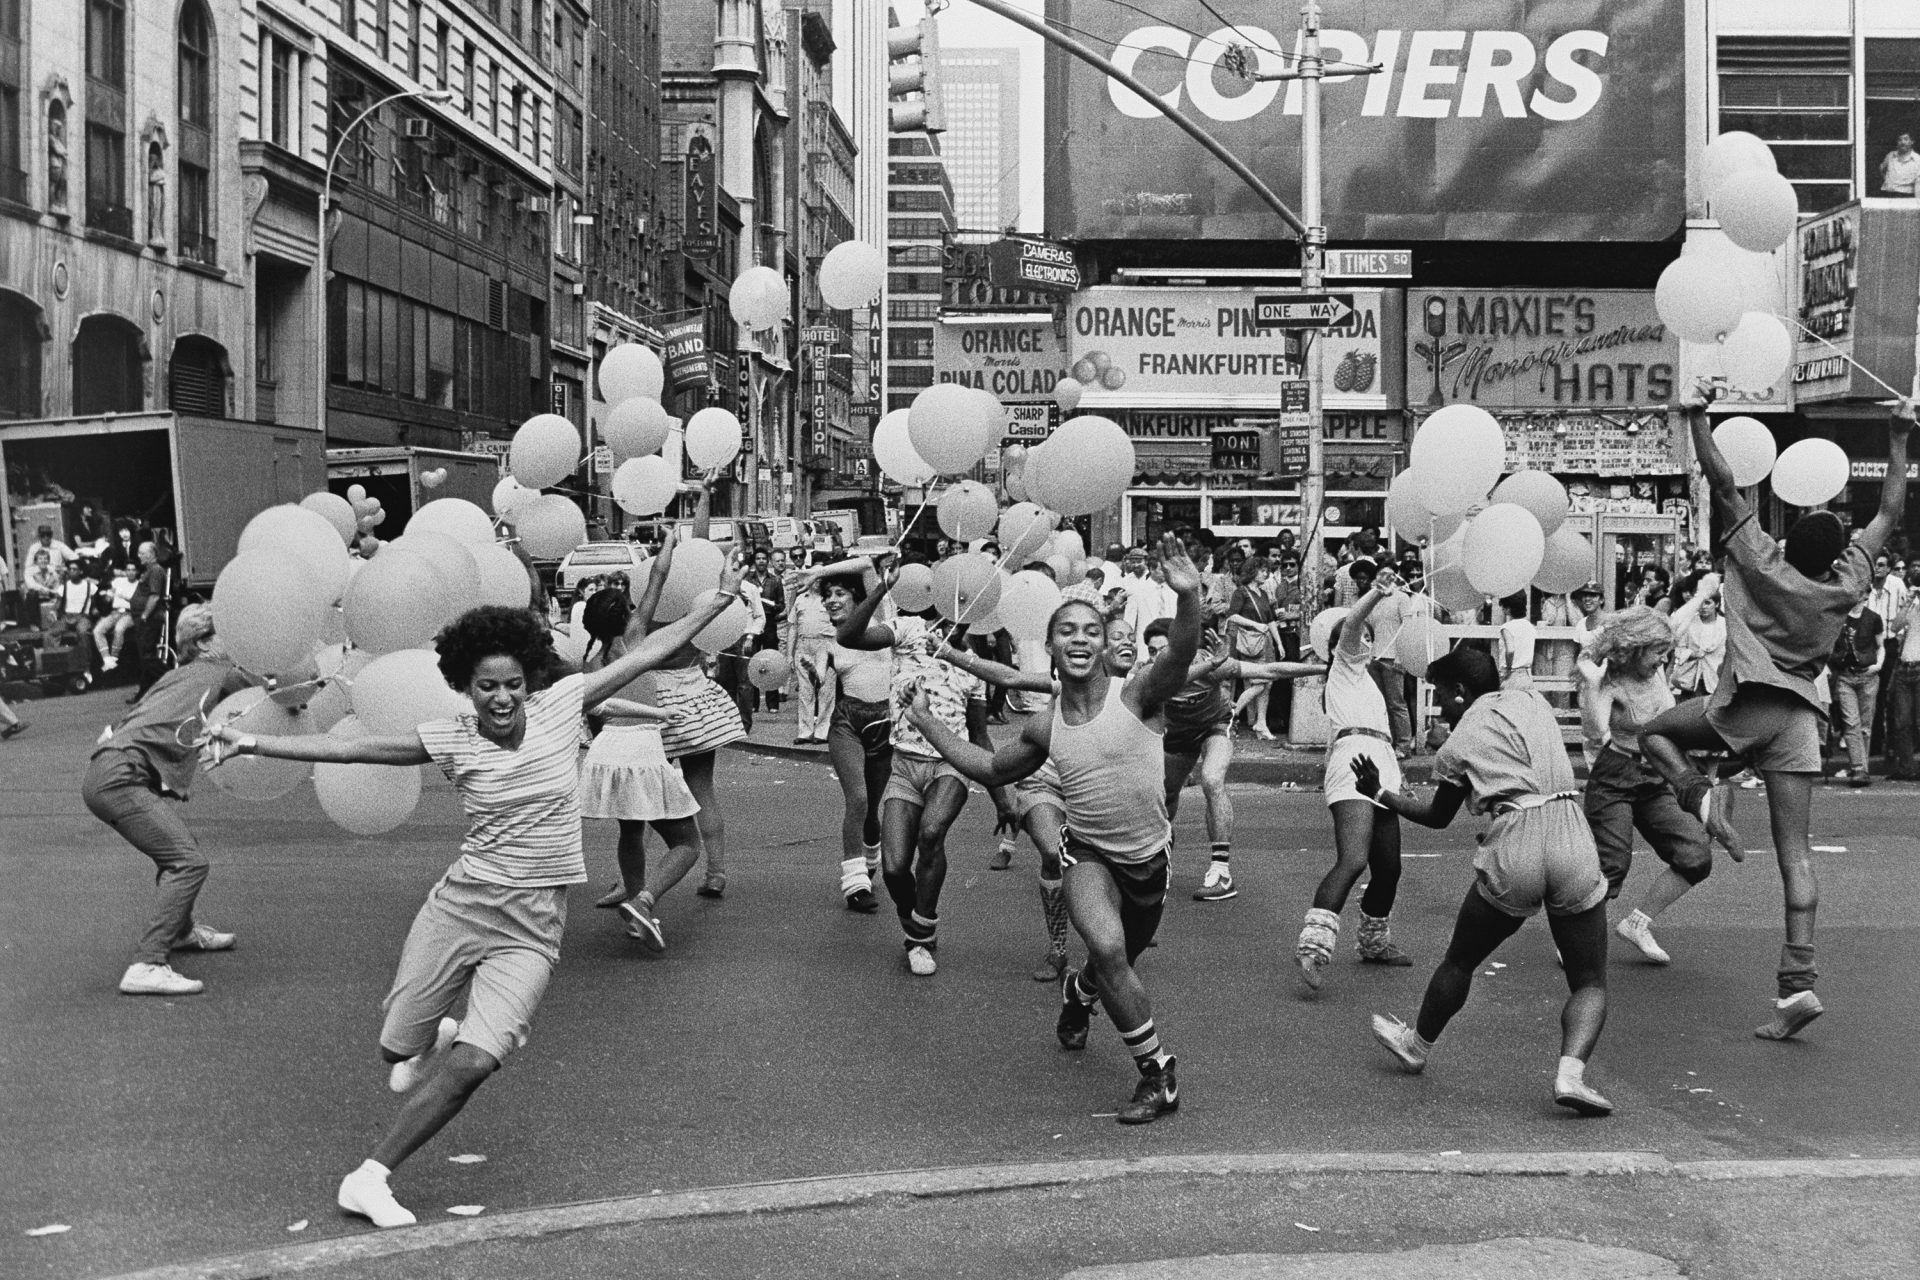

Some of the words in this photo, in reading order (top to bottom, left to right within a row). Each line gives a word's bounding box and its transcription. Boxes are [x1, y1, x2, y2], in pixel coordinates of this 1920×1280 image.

[1107, 25, 1609, 121] COPIERS
[689, 157, 712, 236] EAVES
[1023, 244, 1073, 264] CAMERAS
[1345, 254, 1388, 273] TIMES
[1393, 255, 1408, 265] SQ
[1025, 263, 1077, 284] ELECTRONICS
[1263, 305, 1291, 318] ONE
[1310, 304, 1340, 317] WAY
[1457, 295, 1595, 336] MAXIE'S
[1075, 307, 1176, 337] ORANGE
[802, 329, 838, 342] HOTEL
[961, 329, 1043, 353] ORANGE
[668, 338, 704, 360] BAND
[870, 290, 881, 402] BATHS
[1139, 353, 1300, 376] FRANKFURTER
[1553, 363, 1673, 402] HATS
[851, 406, 879, 415] HOTEL
[1013, 407, 1044, 421] SHARP
[1008, 422, 1046, 436] Casio
[1218, 434, 1259, 449] DONT
[1220, 454, 1259, 470] WALK
[1851, 462, 1919, 478] COCKTLS
